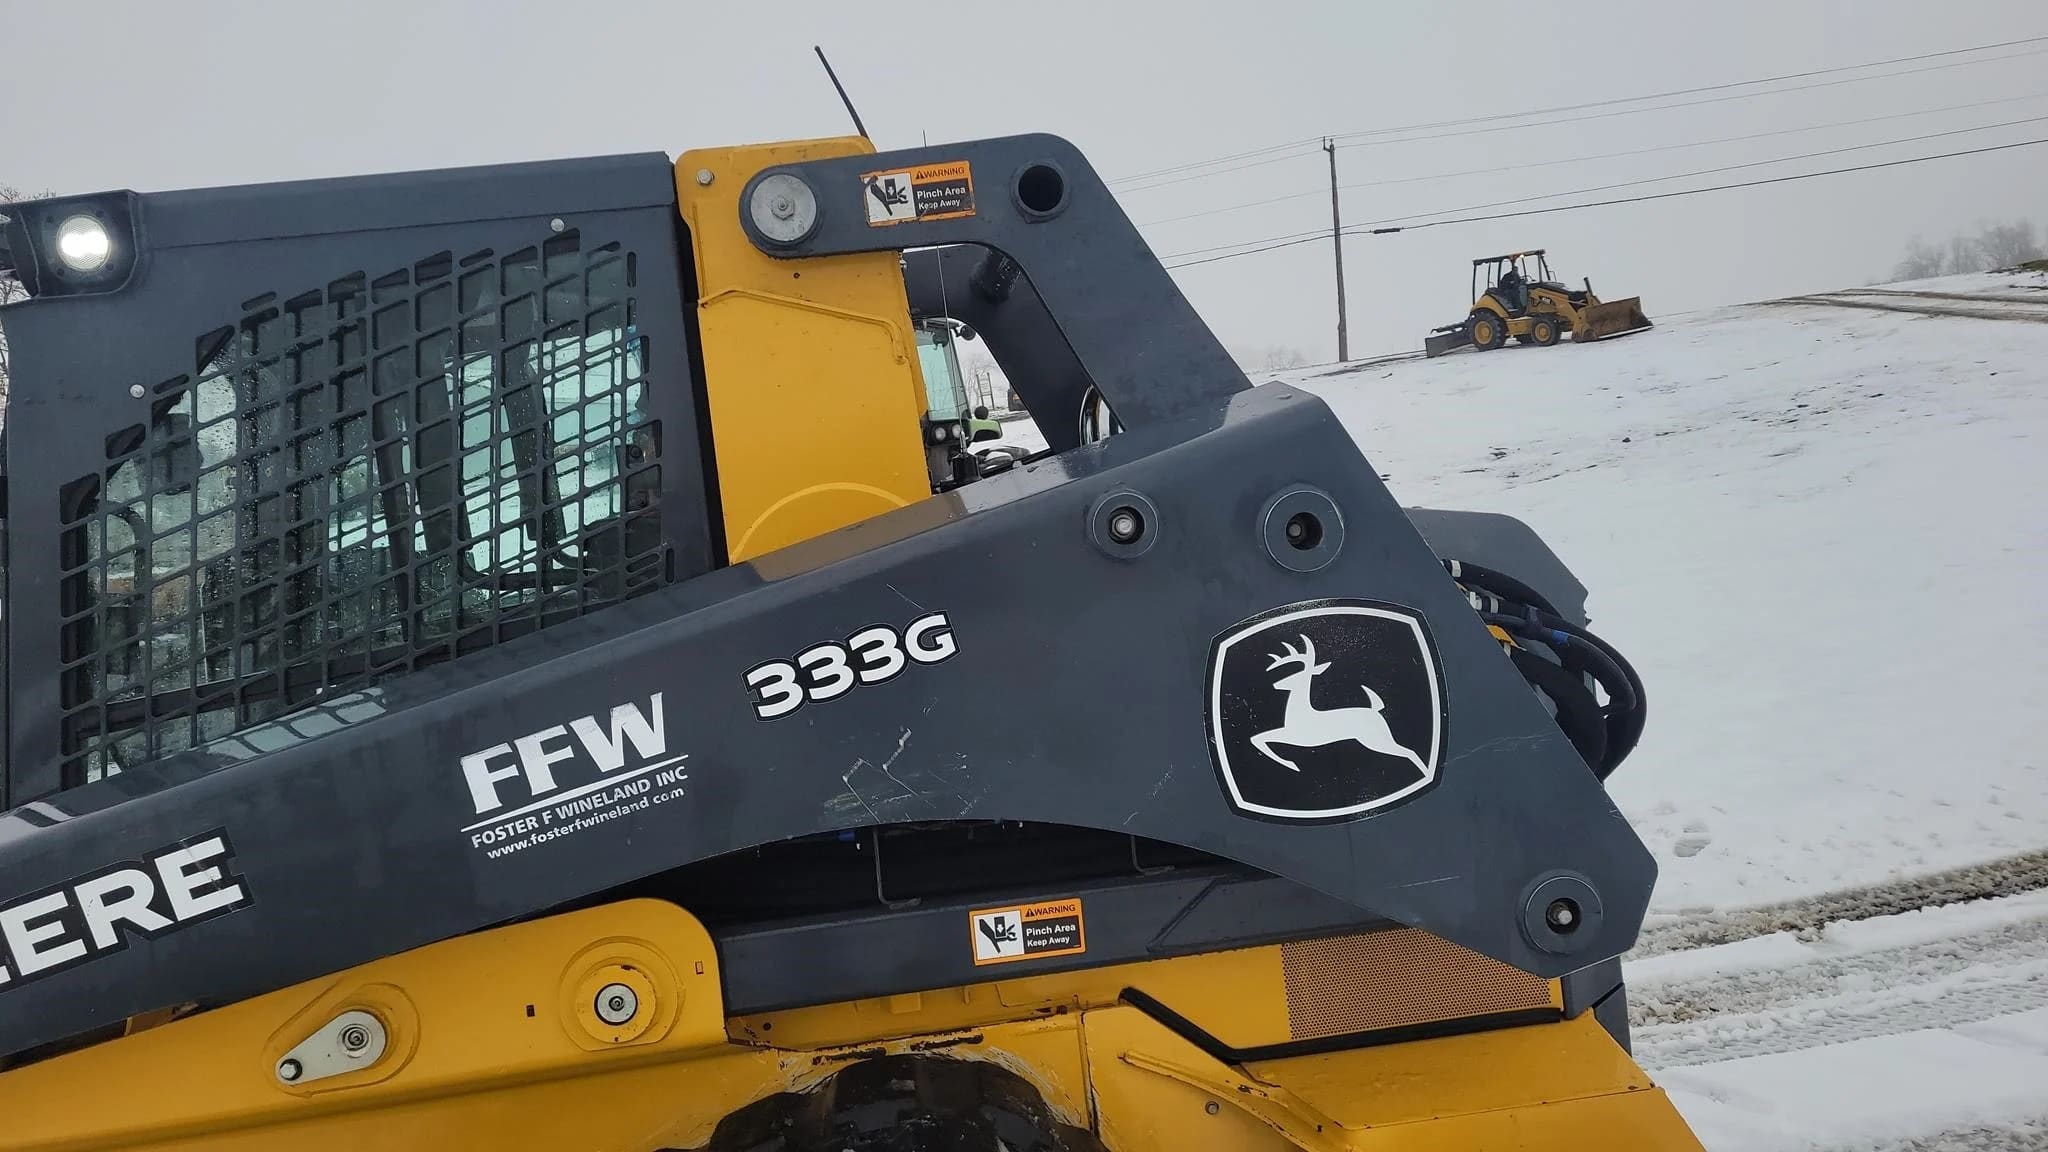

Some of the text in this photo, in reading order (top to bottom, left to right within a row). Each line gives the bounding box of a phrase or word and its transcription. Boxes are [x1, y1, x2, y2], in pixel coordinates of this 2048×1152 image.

[924, 167, 965, 179] WARNING
[917, 186, 966, 200] Pinch Area
[919, 198, 961, 210] Keep Away
[746, 614, 956, 717] 333G
[460, 692, 666, 814] FFW
[471, 766, 688, 848] FOSTER F WINELAND INC
[487, 788, 685, 859] www.fosterfwinelandcom
[0, 837, 244, 985] ERE
[1034, 904, 1075, 916] WARNING
[1026, 923, 1076, 937] Pinch Area
[1027, 936, 1070, 948] Keep Away
